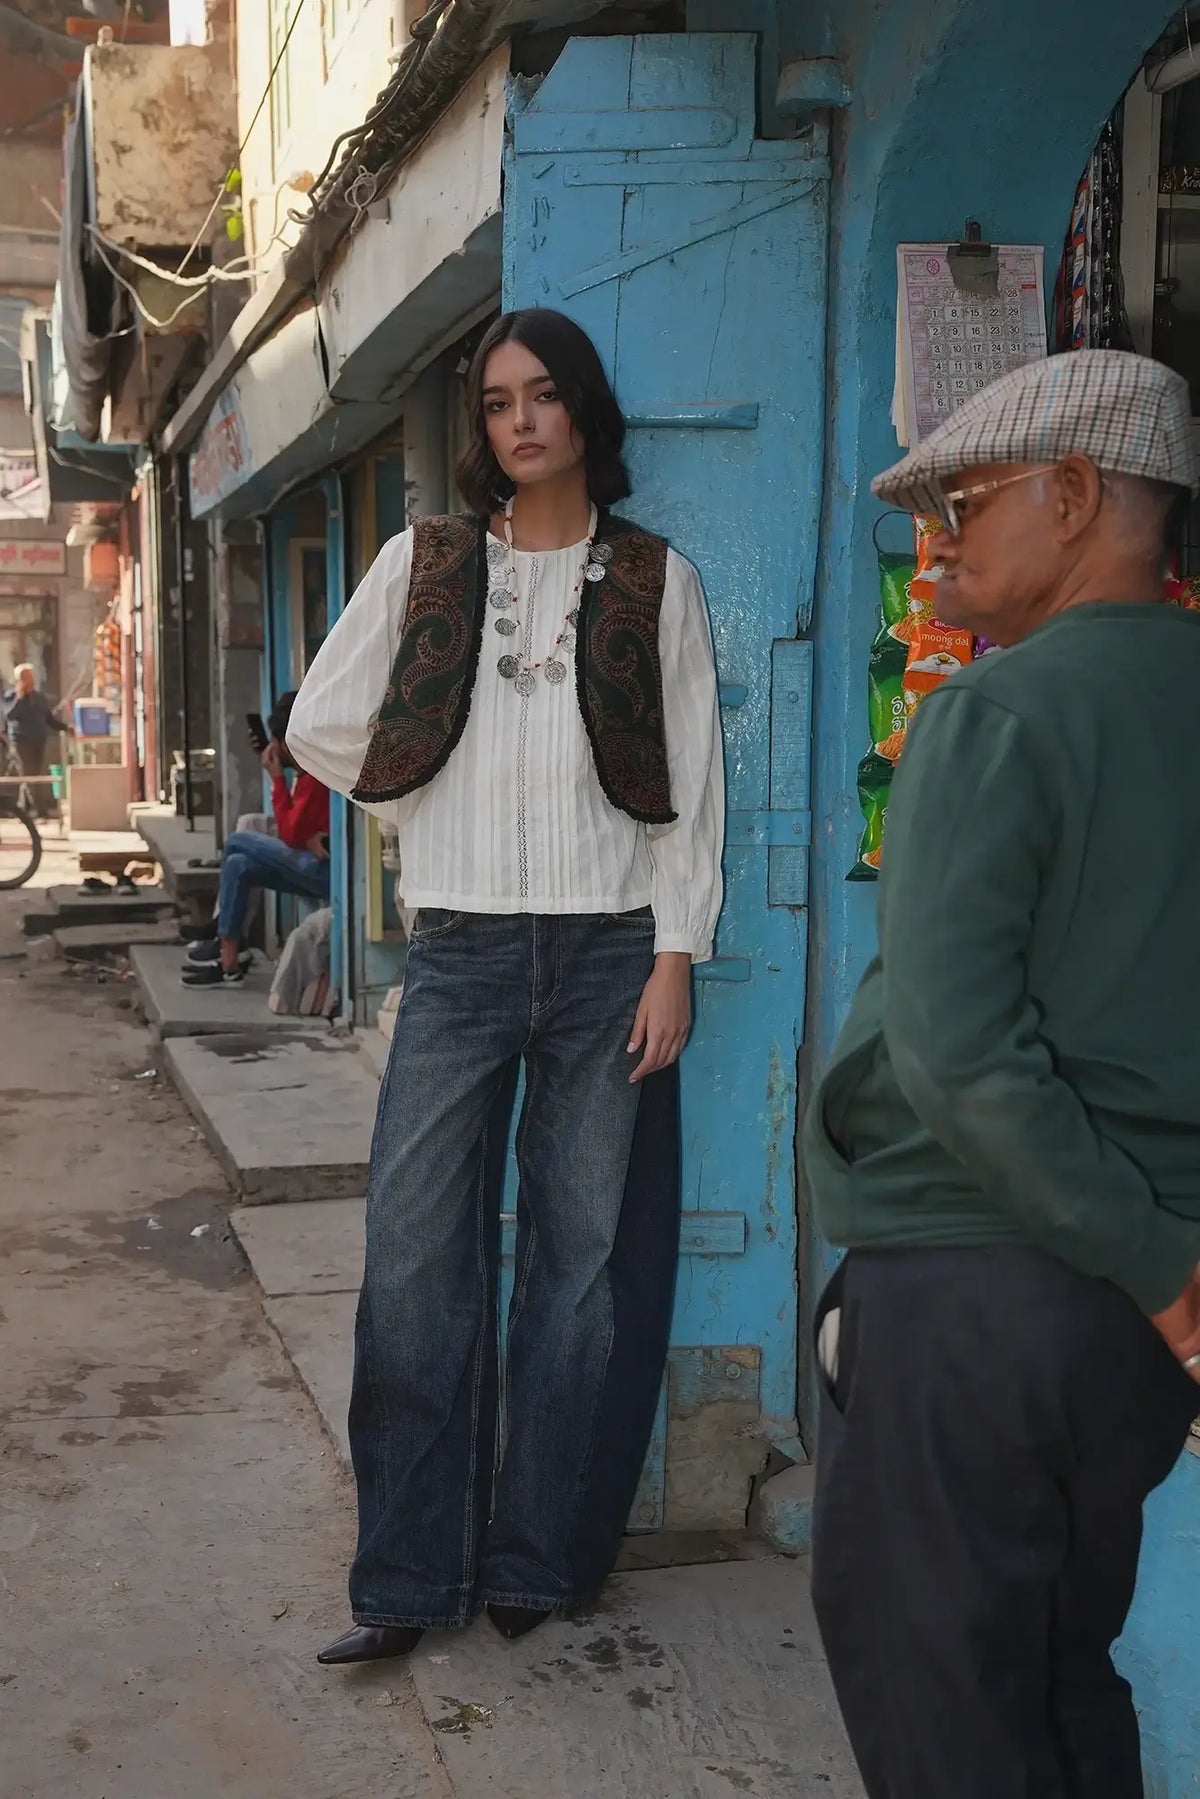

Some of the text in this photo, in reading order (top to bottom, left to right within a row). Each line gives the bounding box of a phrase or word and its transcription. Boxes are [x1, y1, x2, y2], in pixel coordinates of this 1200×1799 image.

[1007, 289, 1018, 297] 28
[951, 309, 957, 317] 8
[970, 309, 979, 317] 15
[989, 308, 999, 317] 22
[1008, 307, 1019, 316] 29
[932, 326, 1019, 336] 2 9 16 23 30
[934, 345, 940, 353] 3
[953, 345, 962, 353] 10
[972, 344, 982, 352] 17
[991, 344, 1001, 352] 24
[1010, 343, 1020, 352] 31
[954, 362, 962, 370] 11
[974, 362, 983, 370] 18
[992, 361, 1002, 370] 25
[937, 380, 984, 389] 5 12 19
[938, 398, 965, 407] 6 13
[921, 633, 953, 647] moong
[955, 637, 969, 646] dal
